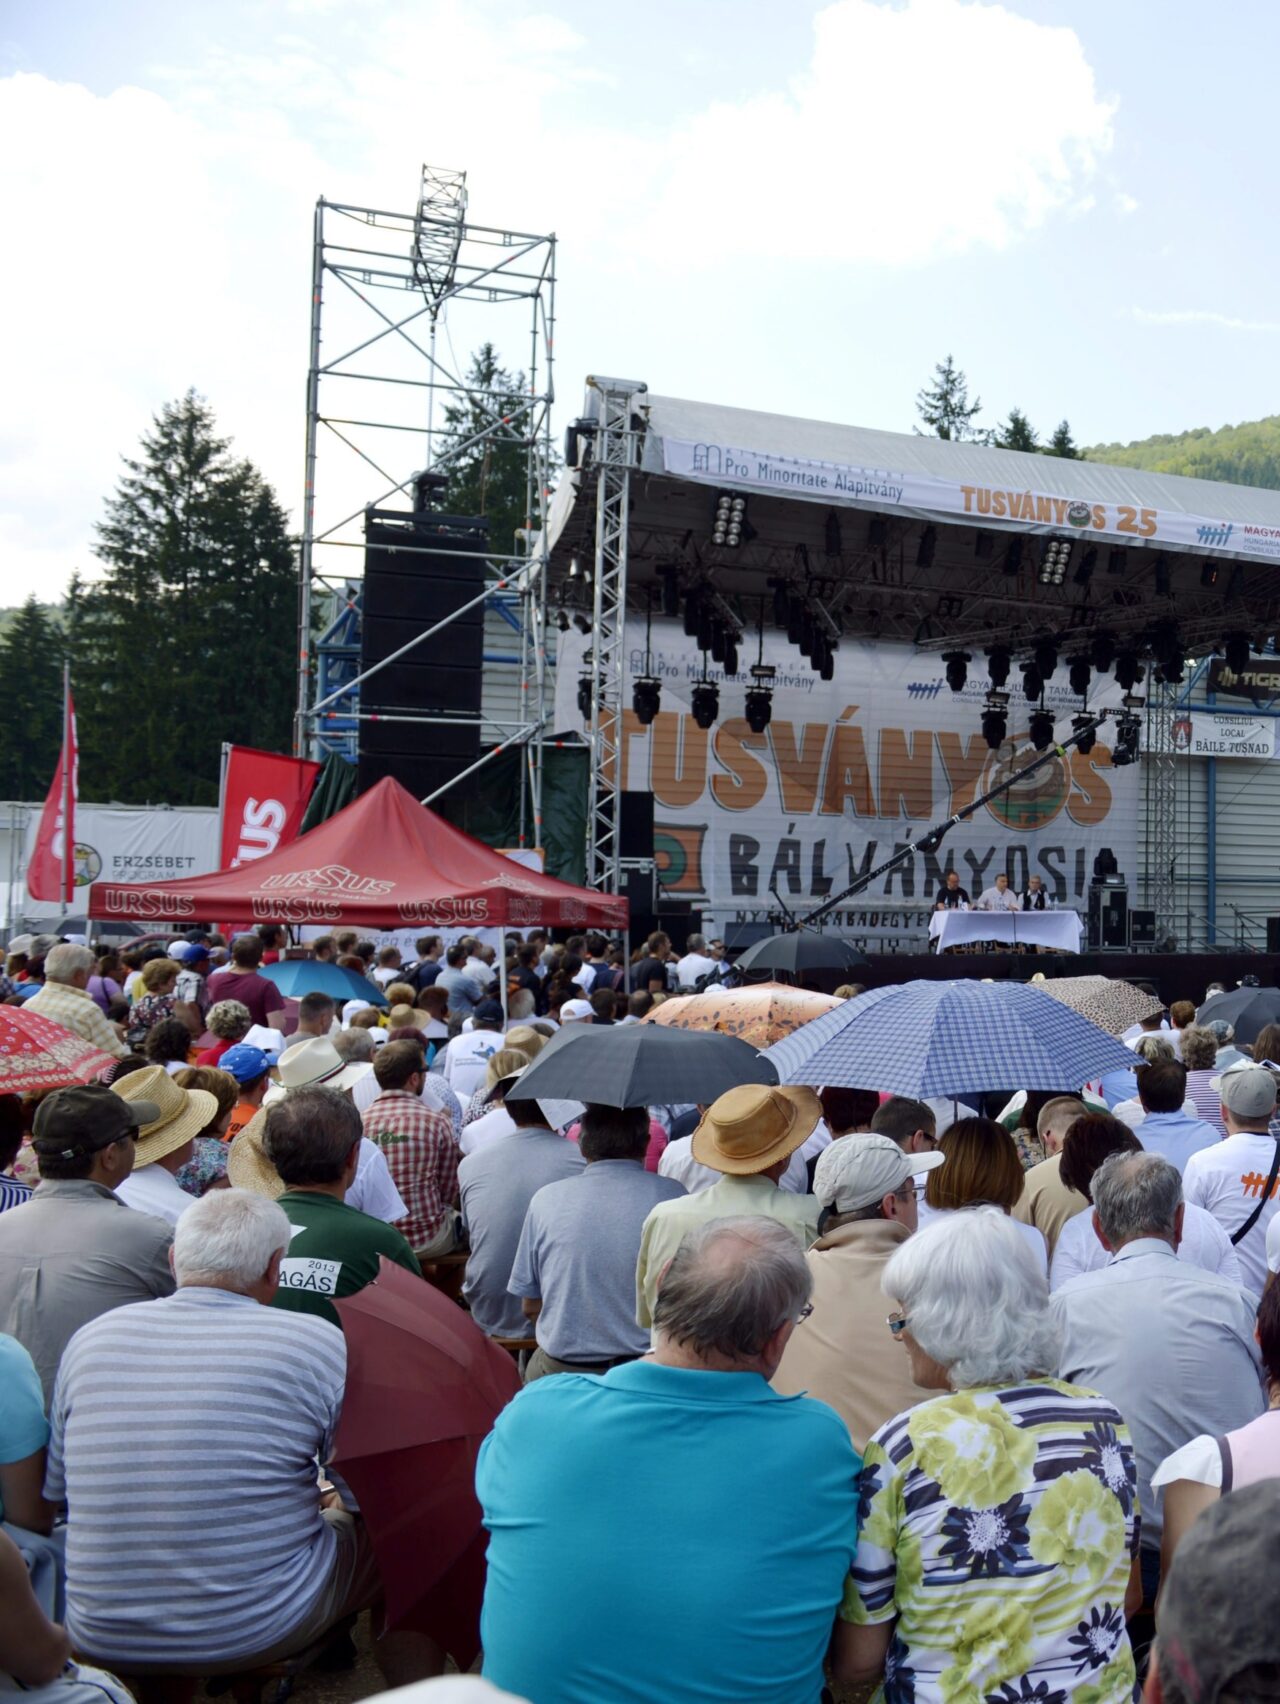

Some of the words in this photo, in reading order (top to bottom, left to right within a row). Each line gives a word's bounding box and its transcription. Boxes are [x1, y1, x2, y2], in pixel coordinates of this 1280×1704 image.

[725, 457, 749, 478] Pro
[757, 462, 828, 488] Minoritate
[834, 473, 904, 503] Alapítvány
[960, 485, 1106, 530] TUSVÁNYOS
[1116, 506, 1158, 537] 25
[658, 661, 679, 676] Pro
[1214, 716, 1254, 726] CONSILIUL
[1221, 728, 1246, 738] LOCAL
[113, 854, 196, 868] ERZSÉBET
[729, 822, 1086, 903] BÁLVÁNYOSI
[112, 870, 176, 880] PROGRAM
[260, 864, 396, 895] URSUS
[105, 889, 197, 918] URSUS
[251, 896, 343, 923] URSUS
[398, 896, 488, 925] URSUS
[308, 1260, 336, 1273] 2013
[279, 1270, 333, 1292] AGÁS
